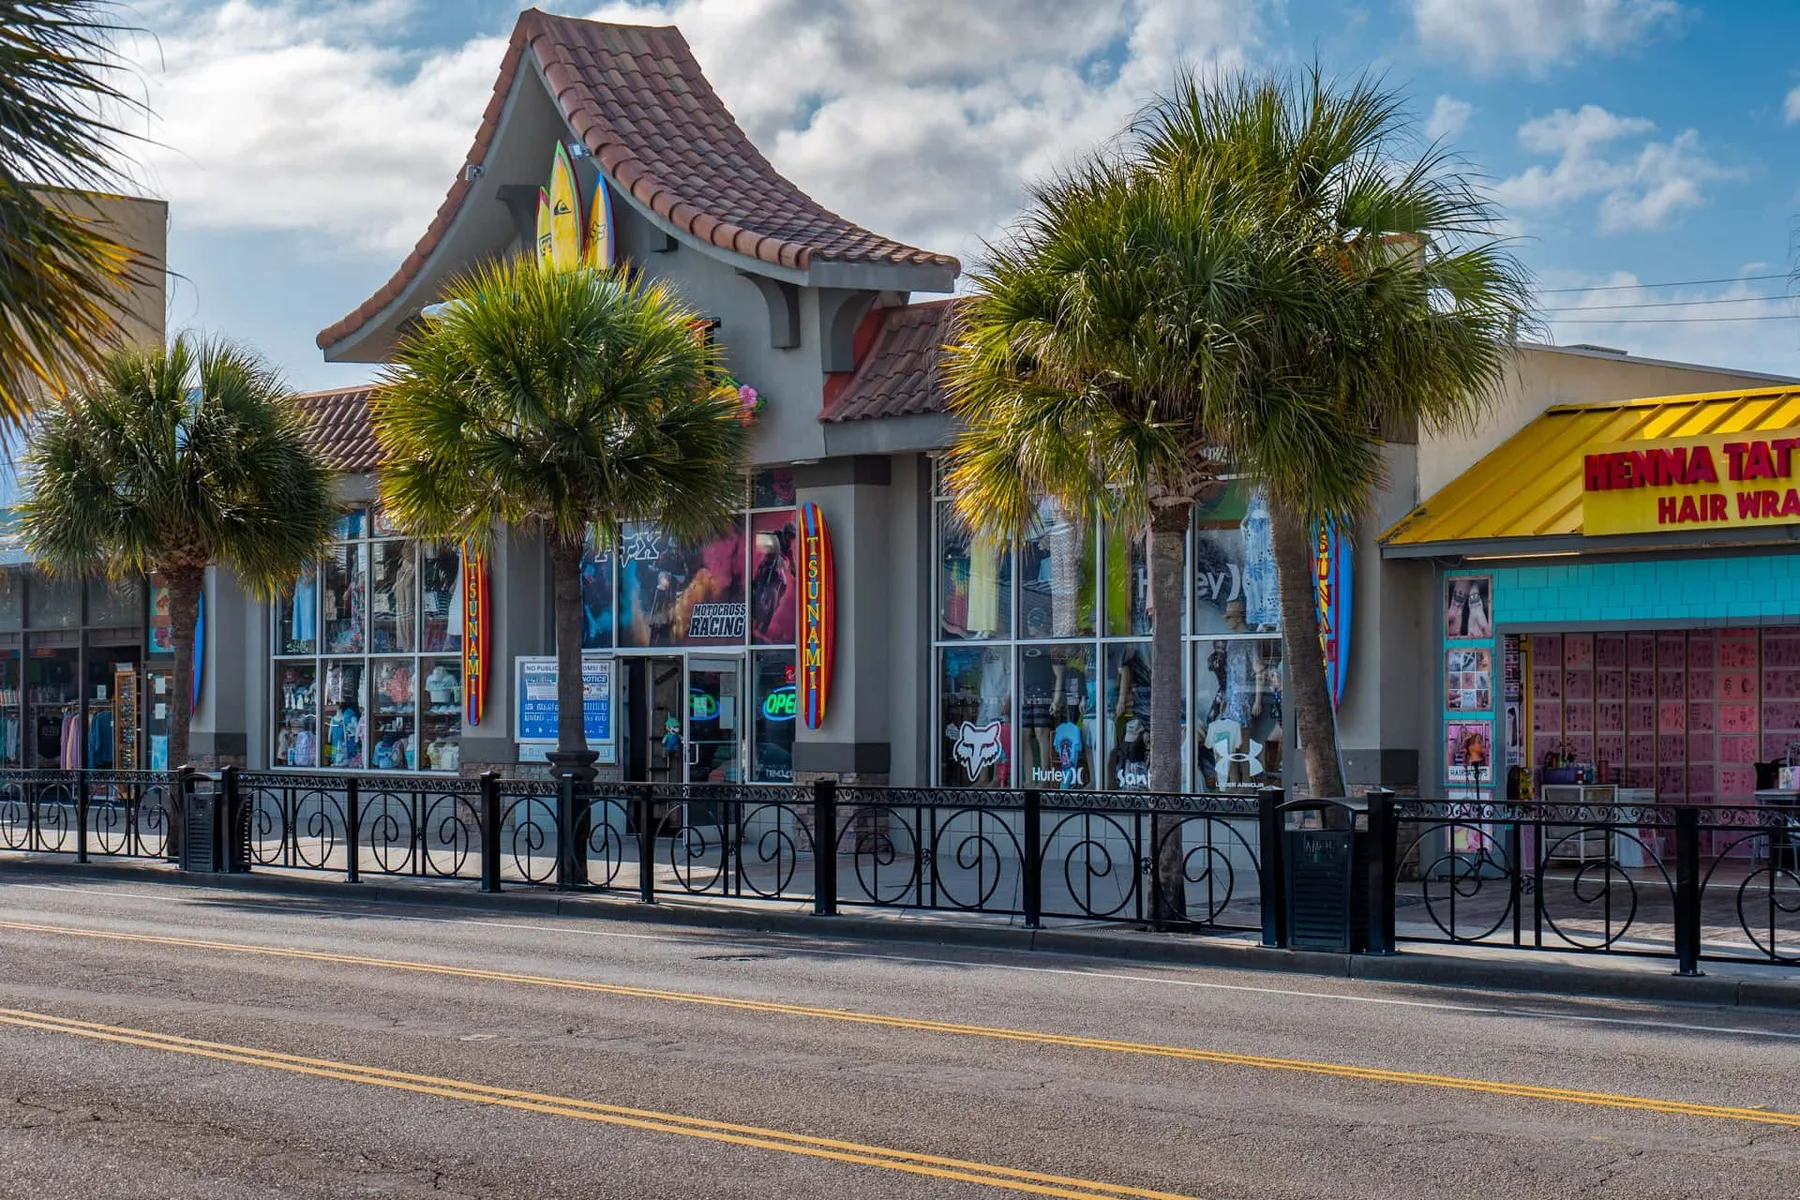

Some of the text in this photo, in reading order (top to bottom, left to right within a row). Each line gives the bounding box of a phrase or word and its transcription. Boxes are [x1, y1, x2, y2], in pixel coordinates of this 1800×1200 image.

[1584, 437, 1800, 491] HENNA TAT
[1657, 494, 1729, 525] HAIR
[693, 603, 747, 617] MOTOCROSS
[804, 536, 821, 690] TSUNAMI
[467, 562, 480, 695] TSUNAMI
[689, 616, 745, 638] RACING
[765, 693, 796, 715] OPE
[1032, 767, 1071, 784] Hurley
